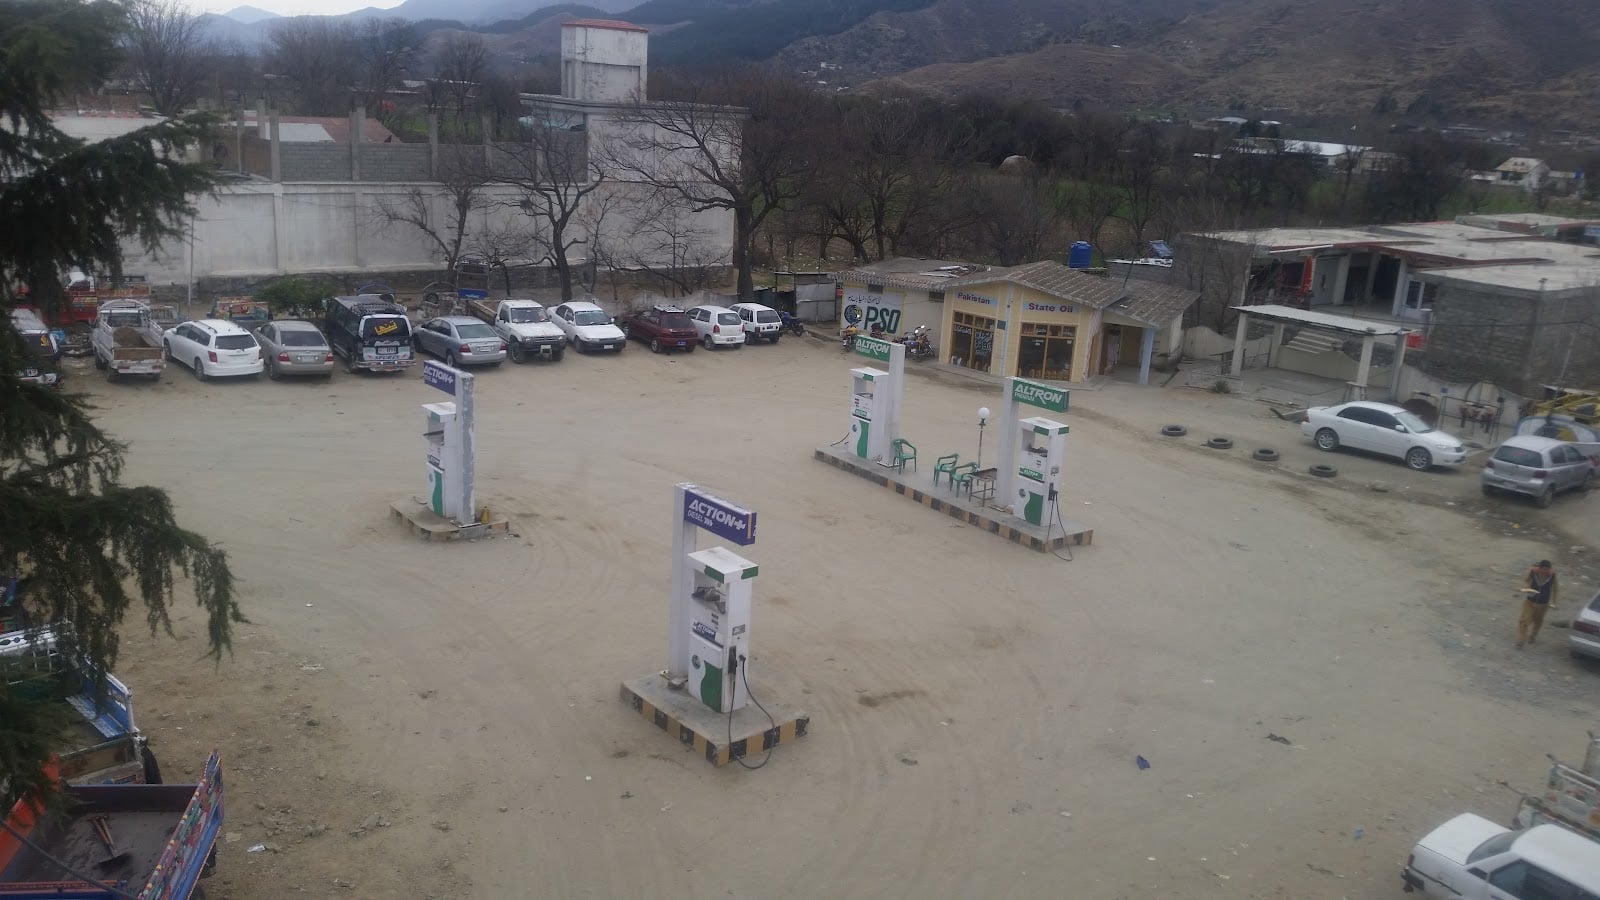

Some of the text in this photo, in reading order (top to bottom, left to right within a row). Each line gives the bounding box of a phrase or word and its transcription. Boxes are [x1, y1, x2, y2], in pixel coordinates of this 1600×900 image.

[957, 292, 991, 305] Pakistan
[1028, 302, 1073, 313] State Oil
[864, 306, 901, 334] PSO
[856, 338, 890, 356] ALTRON
[1015, 383, 1063, 405] ALTRON
[687, 509, 704, 523] DIESEL
